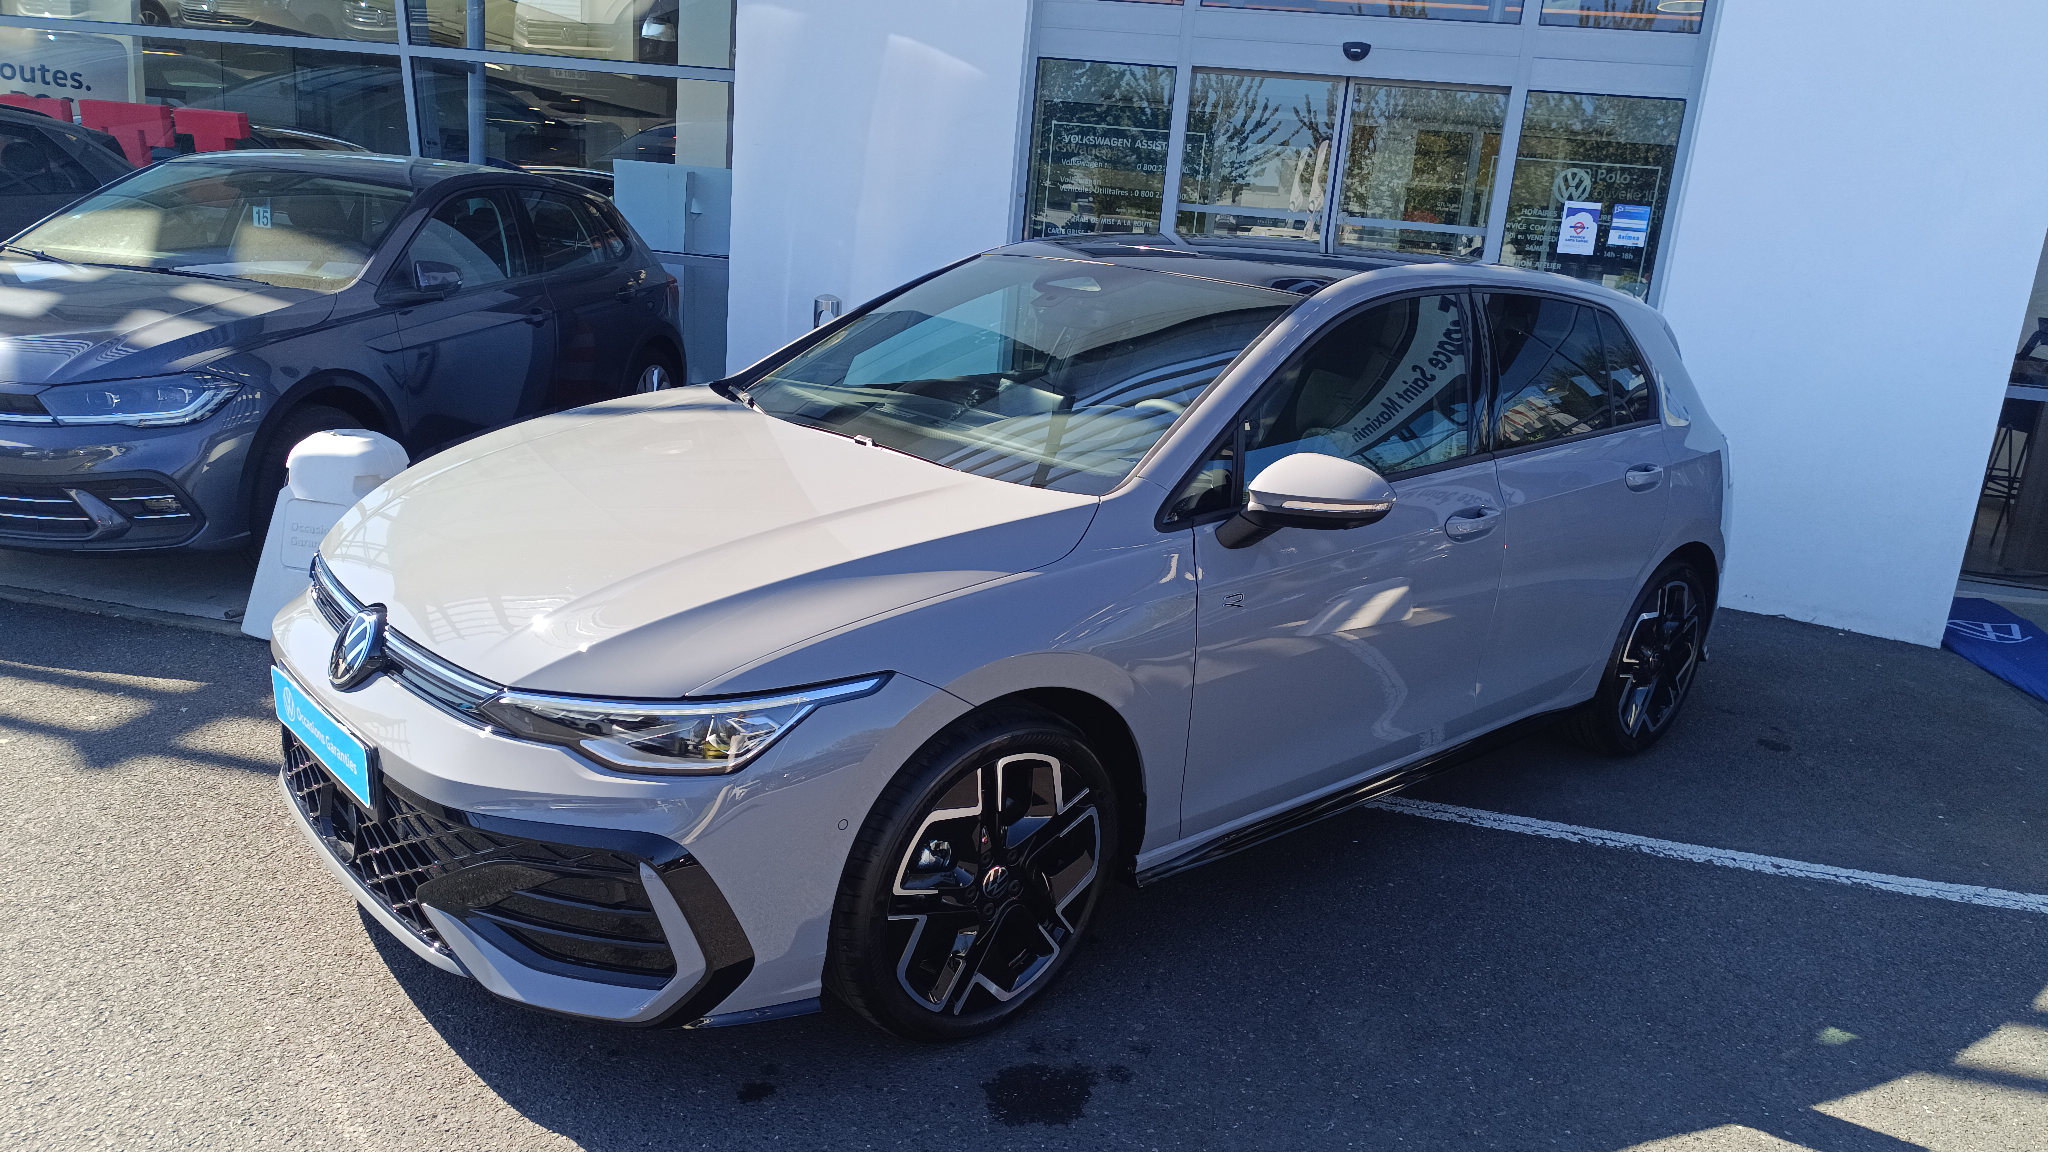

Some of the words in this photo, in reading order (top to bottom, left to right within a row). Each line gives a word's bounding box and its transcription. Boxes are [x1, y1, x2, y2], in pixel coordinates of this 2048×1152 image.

[1064, 133, 1131, 148] VOLKSWAGEN
[1061, 158, 1103, 169] Volkswagen
[1060, 175, 1101, 187] Volkswagen
[255, 208, 269, 227] 15
[1521, 207, 1558, 218] HORAIRES
[1505, 221, 1527, 230] RVICE
[1529, 223, 1560, 233] COMME
[290, 522, 329, 535] Occasio
[296, 706, 326, 744] Occasions
[325, 735, 358, 776] Garanties
